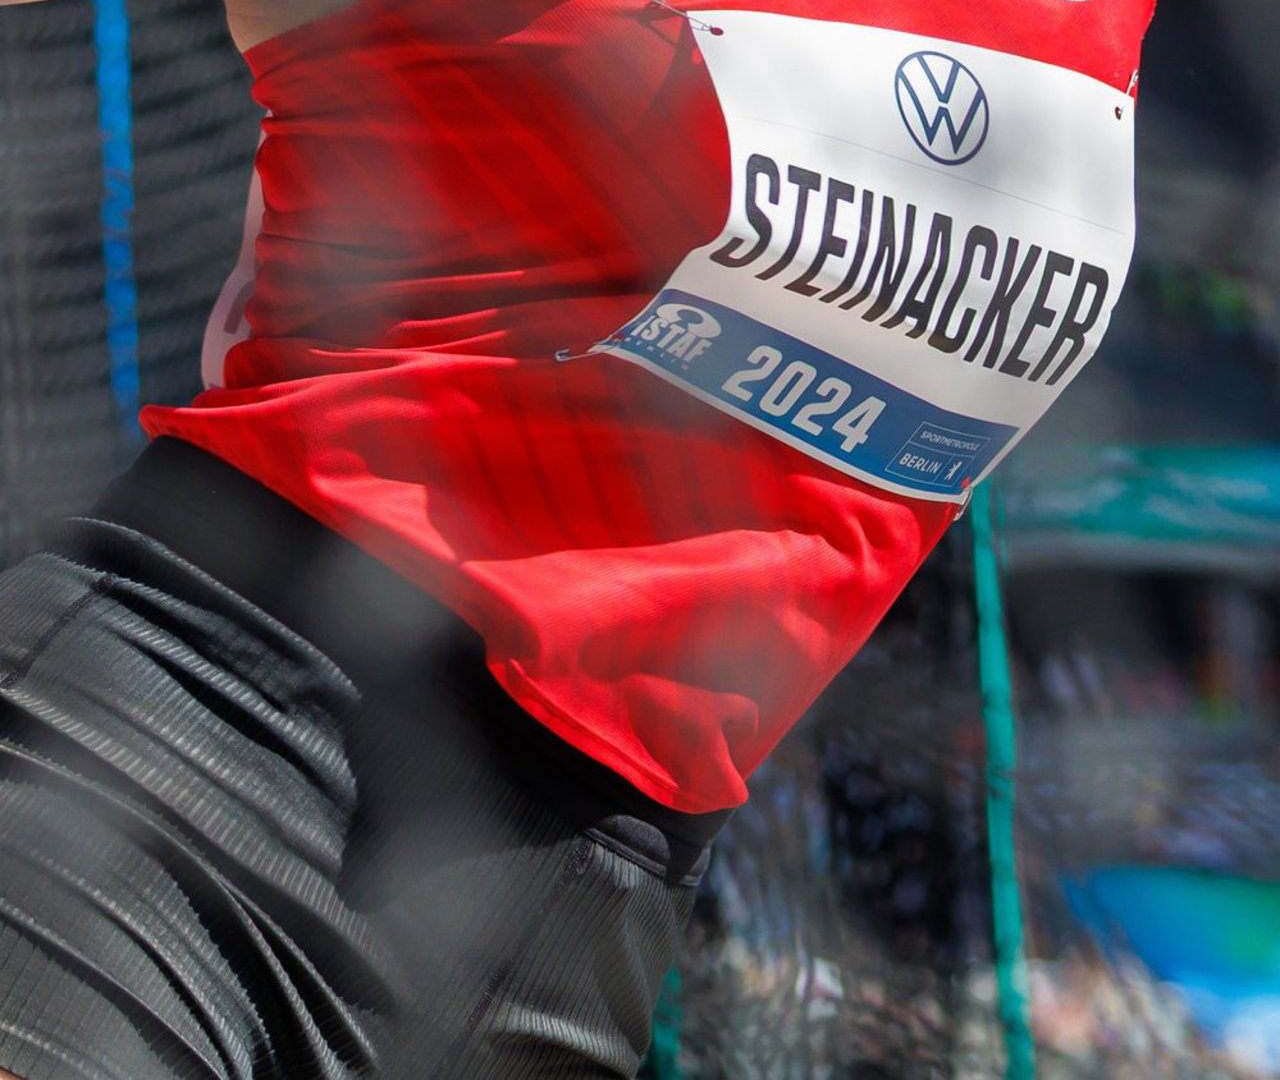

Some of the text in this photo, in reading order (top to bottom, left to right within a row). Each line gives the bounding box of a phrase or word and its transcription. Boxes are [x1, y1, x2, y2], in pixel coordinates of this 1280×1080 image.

[710, 154, 1109, 386] STEINACKER
[721, 345, 886, 453] 2024
[899, 453, 942, 474] BERLIN
